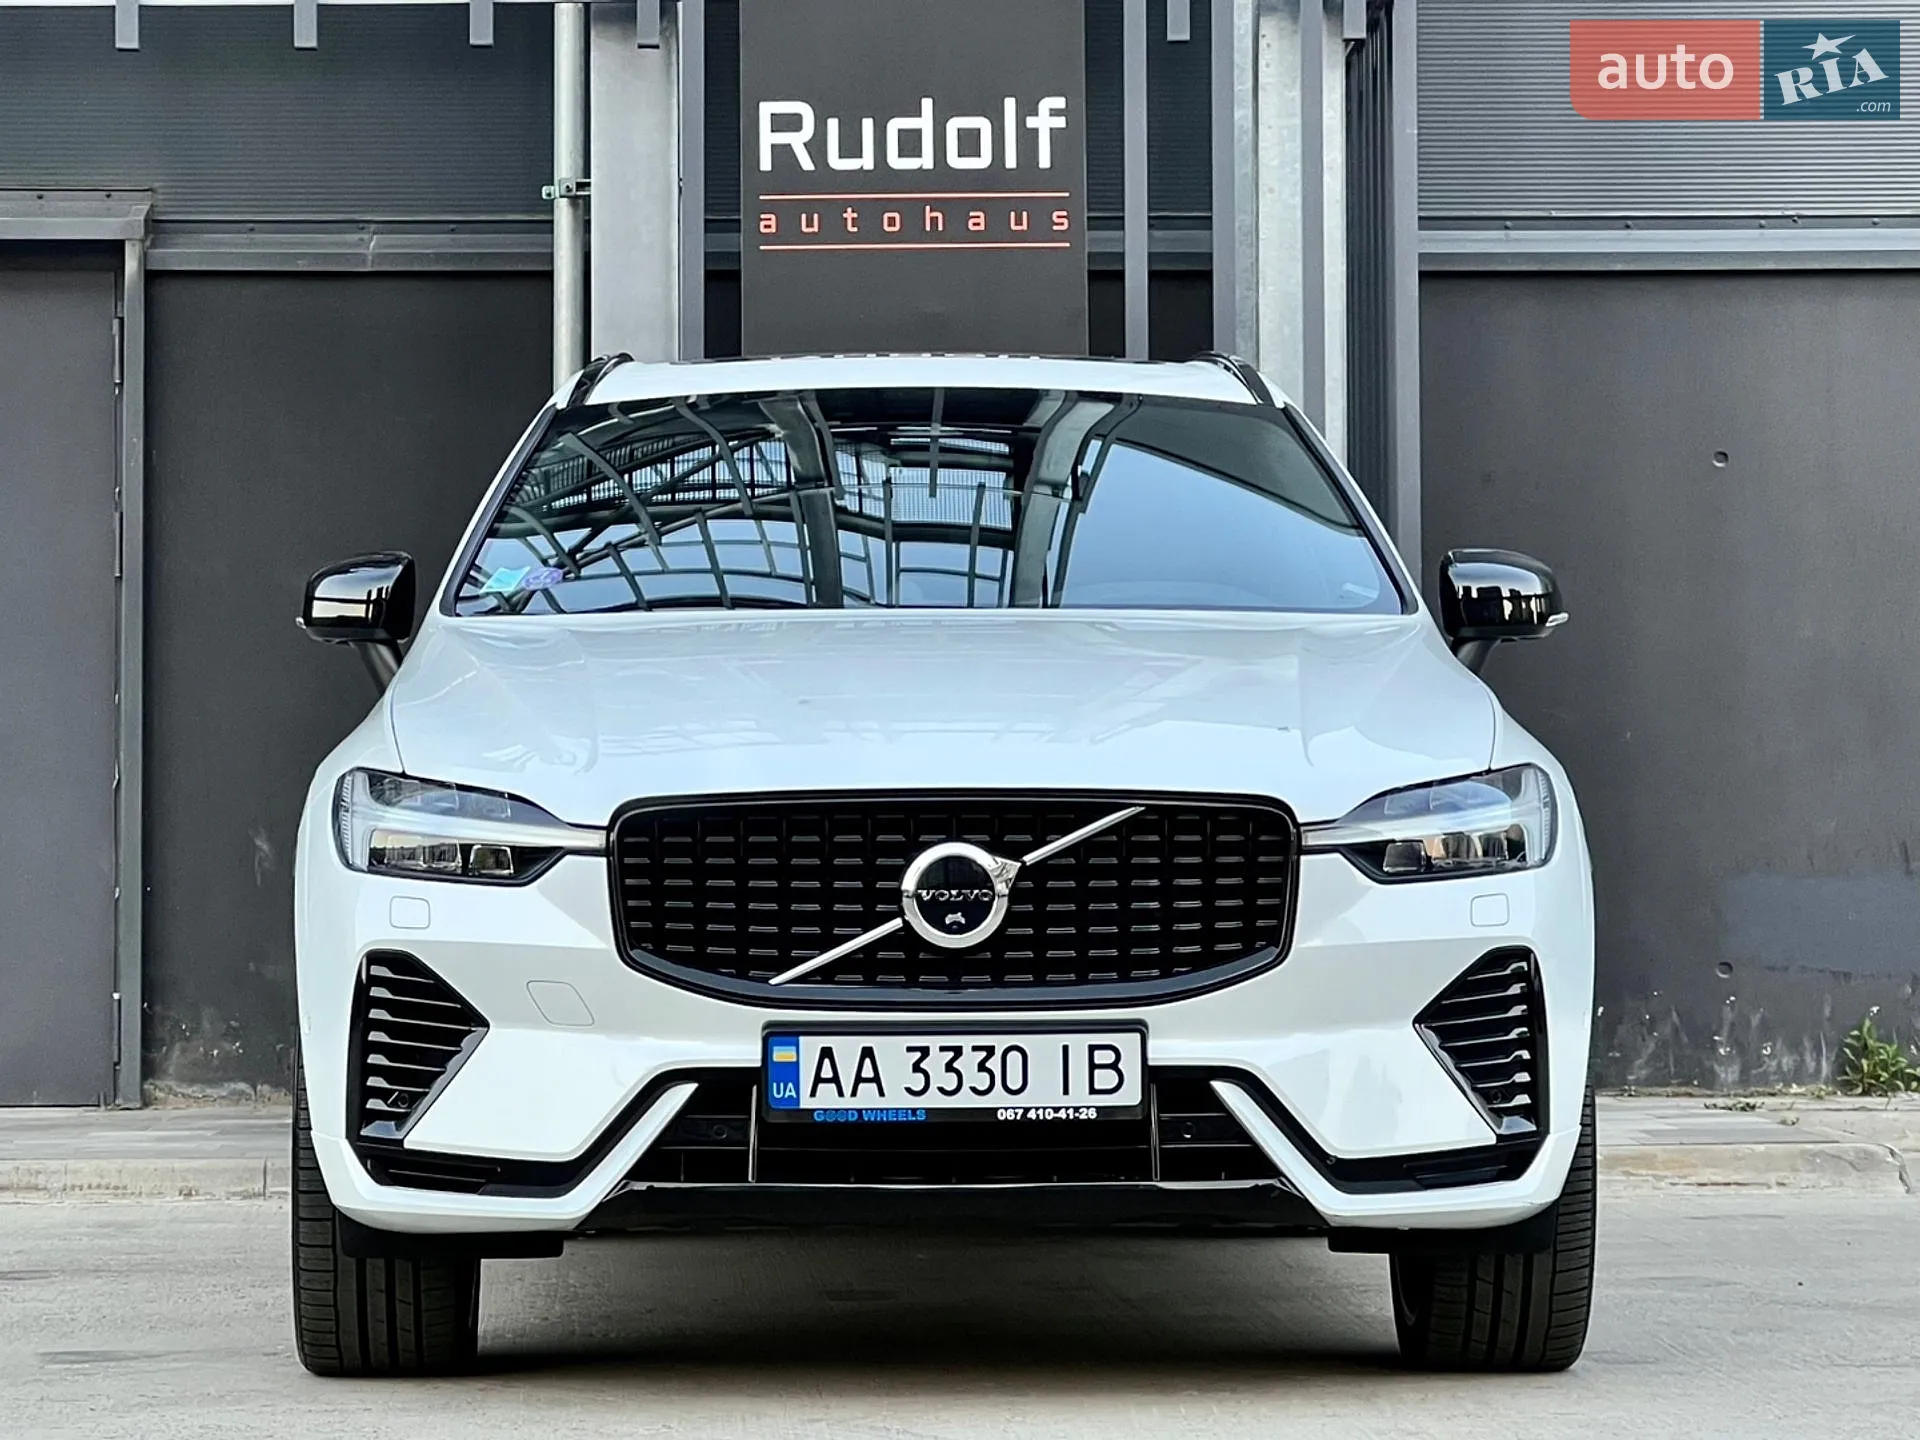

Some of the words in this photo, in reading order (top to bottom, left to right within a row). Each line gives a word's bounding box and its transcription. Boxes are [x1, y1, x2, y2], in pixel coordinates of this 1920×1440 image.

[758, 96, 1067, 171] Rudolf
[759, 205, 1069, 233] autohaus
[917, 889, 993, 901] VOLVO
[809, 1046, 886, 1098] AA
[903, 1044, 1028, 1097] 3330
[1061, 1043, 1125, 1096] IB
[773, 1083, 797, 1099] UA
[813, 1109, 858, 1121] GOOD
[862, 1109, 927, 1121] WHEELS
[997, 1108, 1023, 1120] 067
[1026, 1107, 1097, 1120] 410-41-26
